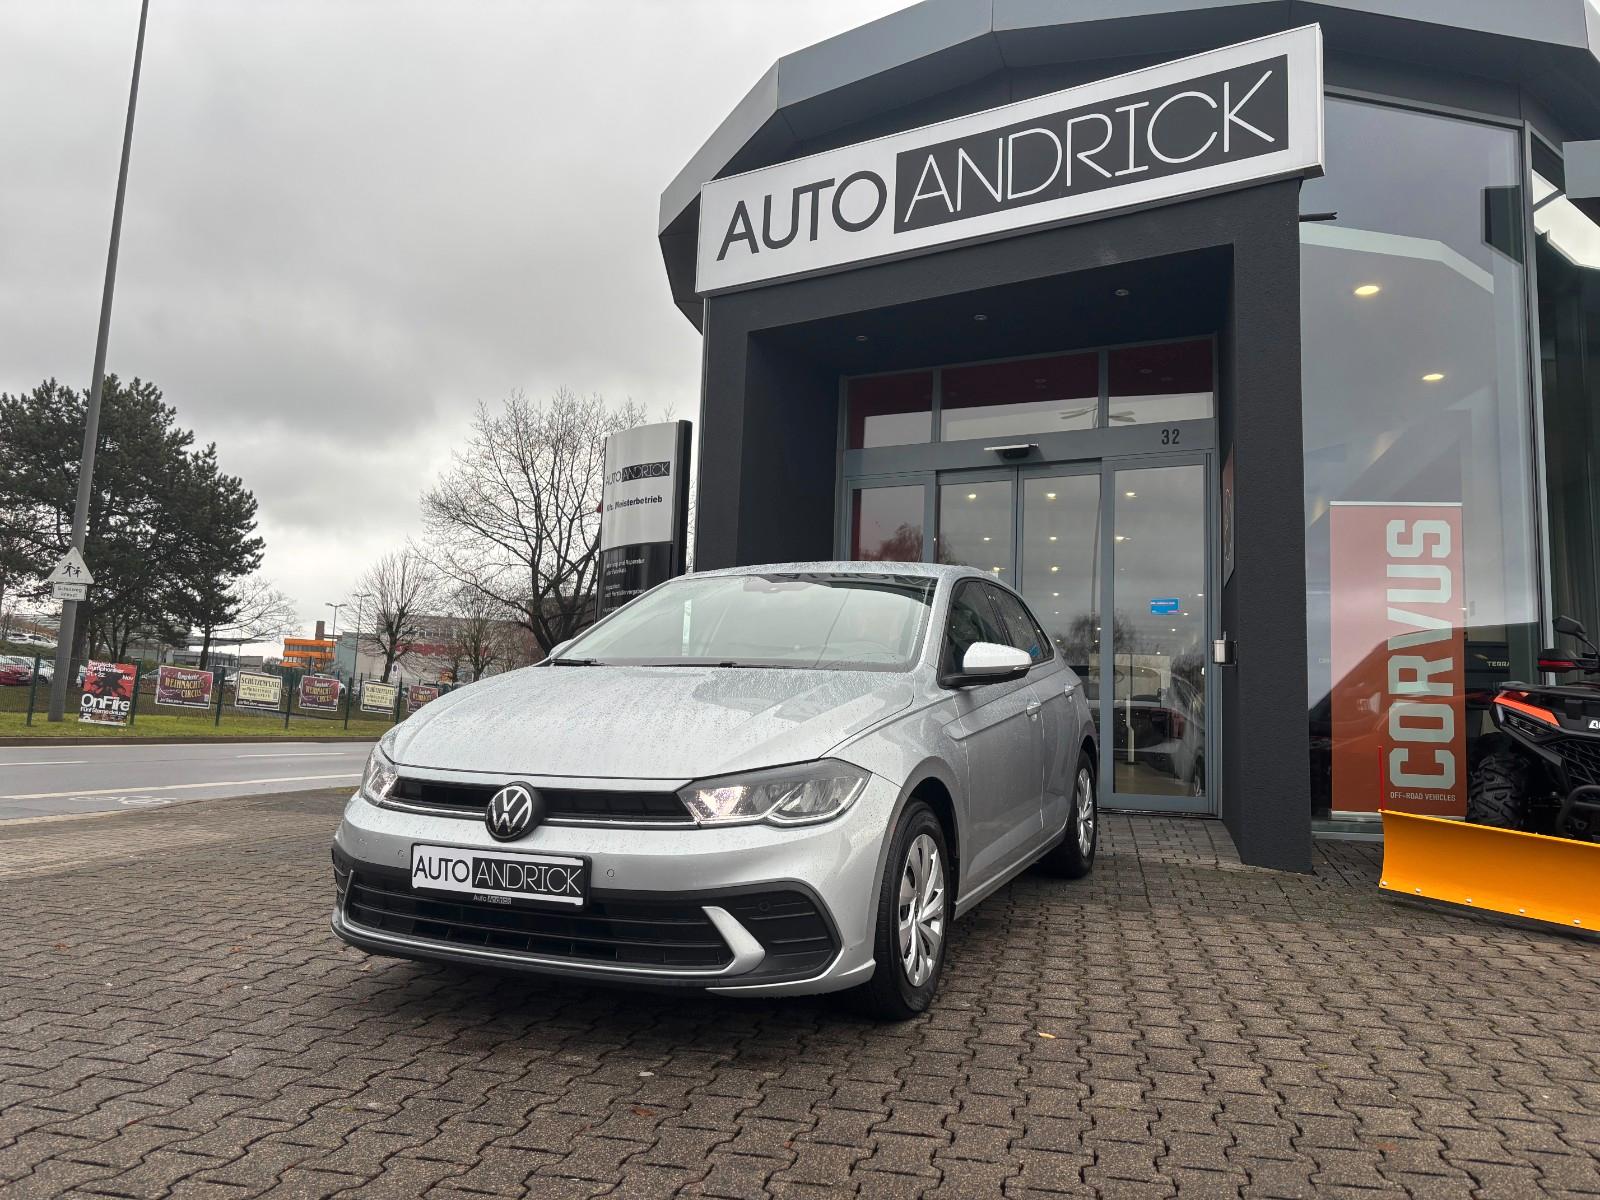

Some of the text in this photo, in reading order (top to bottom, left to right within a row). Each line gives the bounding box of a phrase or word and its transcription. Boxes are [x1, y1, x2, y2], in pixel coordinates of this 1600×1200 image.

[716, 70, 1276, 262] AUTO ANDRICK
[1161, 428, 1180, 445] 32
[622, 462, 669, 480] ANDRICK
[1386, 519, 1456, 790] CORVUS
[1390, 791, 1456, 802] OFF-ROAD VEHICLES
[413, 855, 582, 895] AUTO ANDRICK
